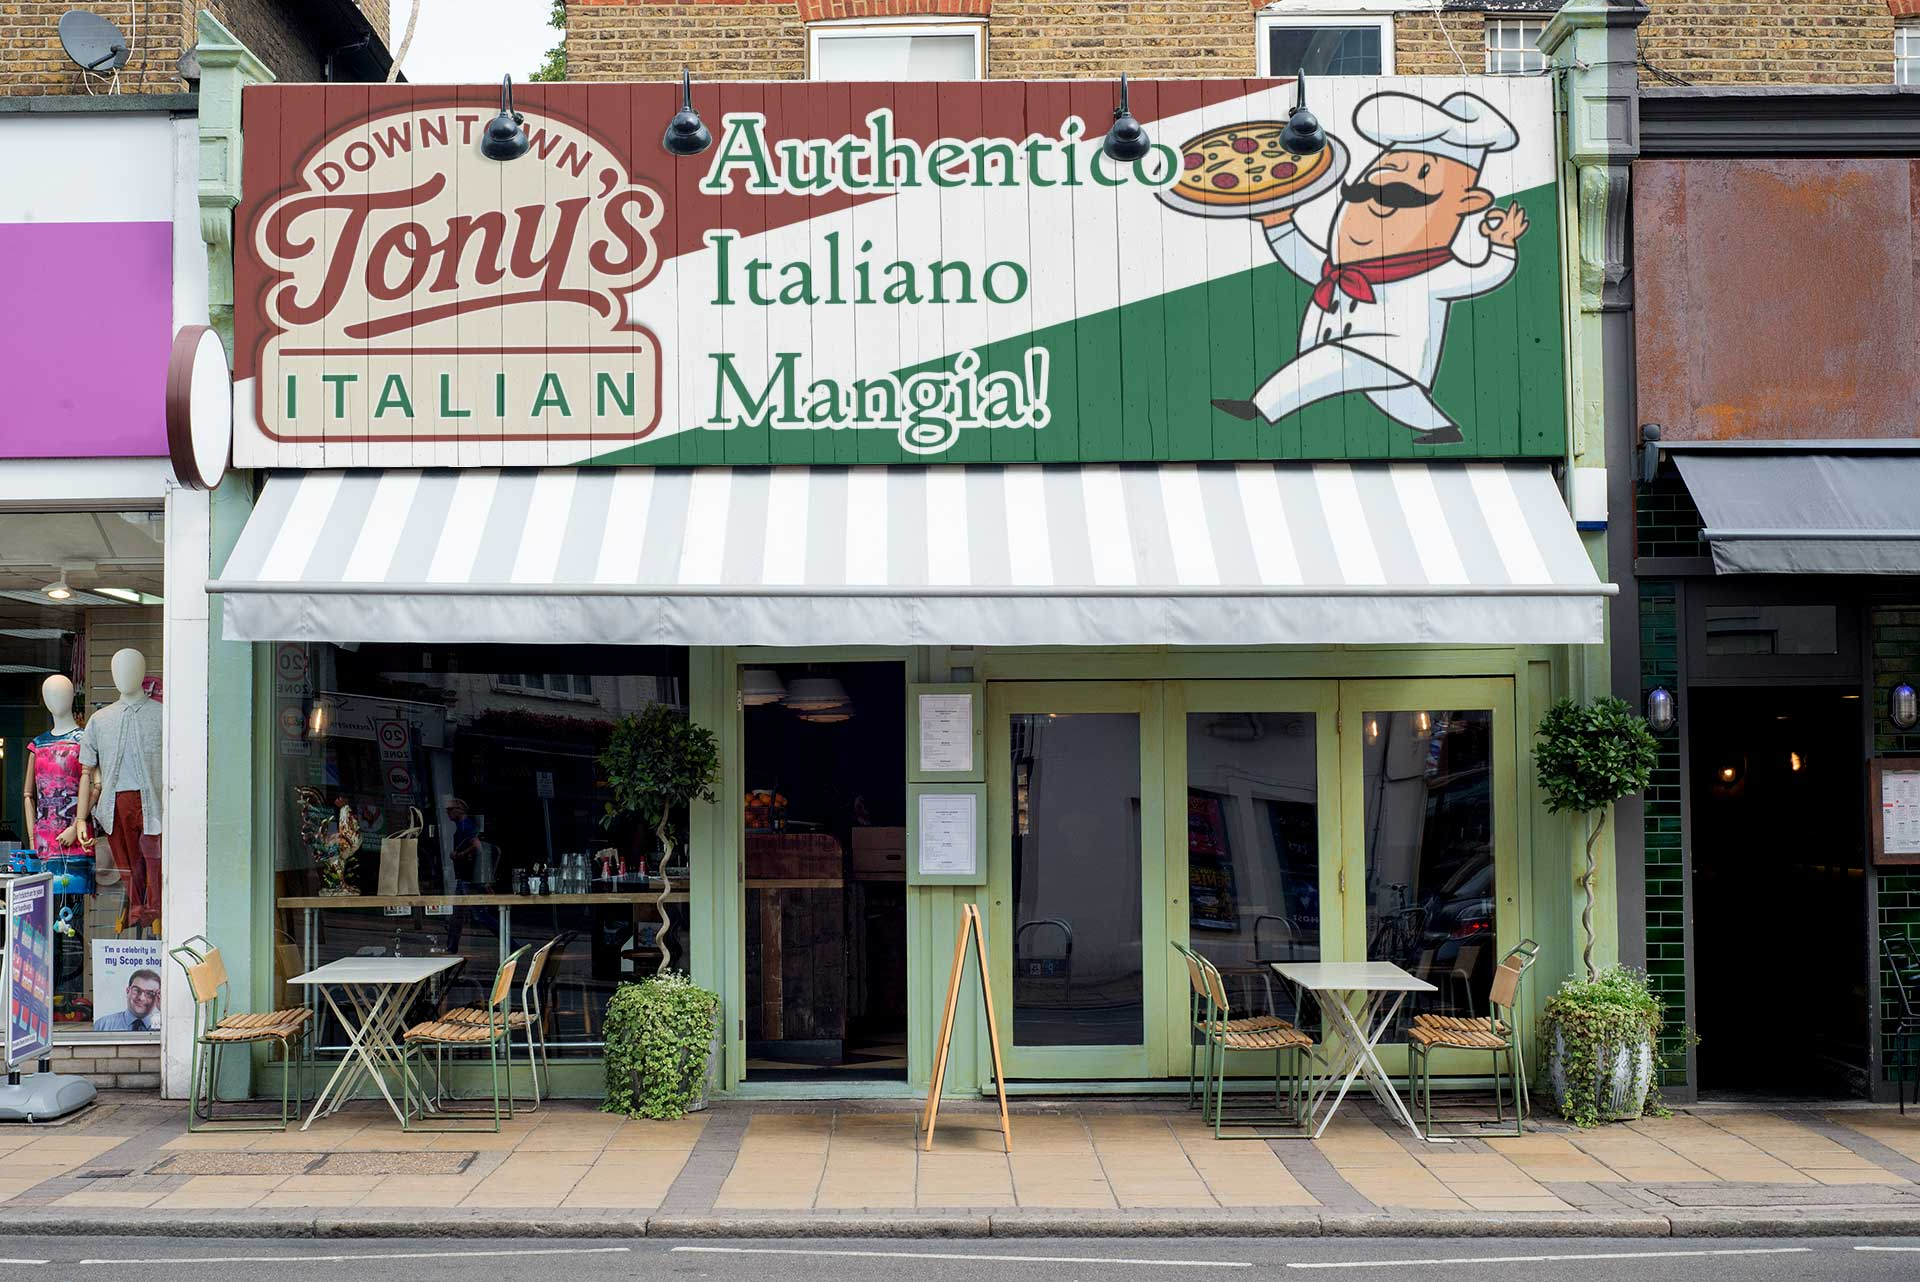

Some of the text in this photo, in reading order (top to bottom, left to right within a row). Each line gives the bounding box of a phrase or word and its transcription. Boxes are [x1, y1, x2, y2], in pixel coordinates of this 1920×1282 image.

[313, 115, 593, 192] DOWNTWN
[706, 114, 1179, 189] Authentico
[265, 167, 655, 339] Tony's
[709, 231, 1029, 306] Italiano
[286, 371, 635, 419] ITALIAN
[708, 352, 1045, 447] Mangia!
[105, 957, 117, 966] my
[120, 956, 143, 967] Scope
[122, 946, 149, 955] celebrity
